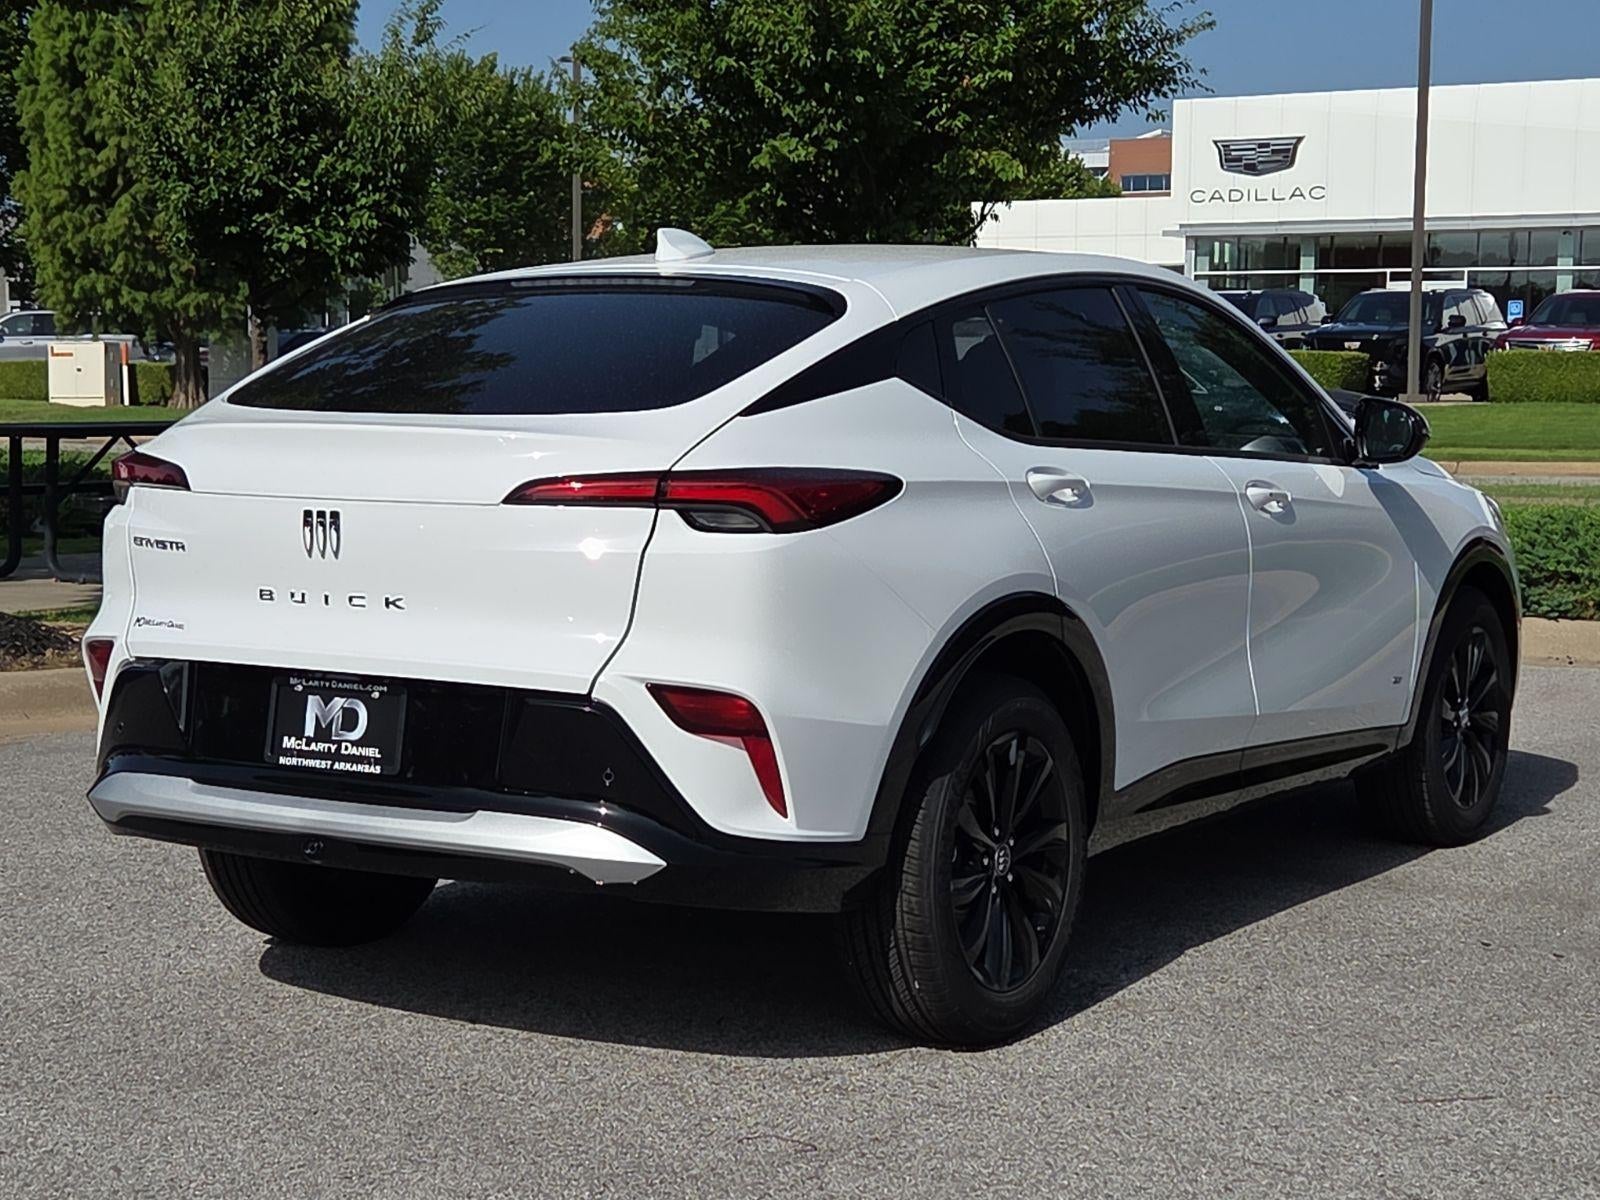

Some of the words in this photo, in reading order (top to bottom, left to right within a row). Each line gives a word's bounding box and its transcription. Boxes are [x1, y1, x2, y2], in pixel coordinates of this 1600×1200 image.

[1190, 186, 1326, 203] CADILLAC
[259, 588, 405, 610] BUICK
[304, 694, 368, 741] MD
[279, 756, 332, 770] NORTHWEST
[333, 761, 381, 774] ARKANSAS
